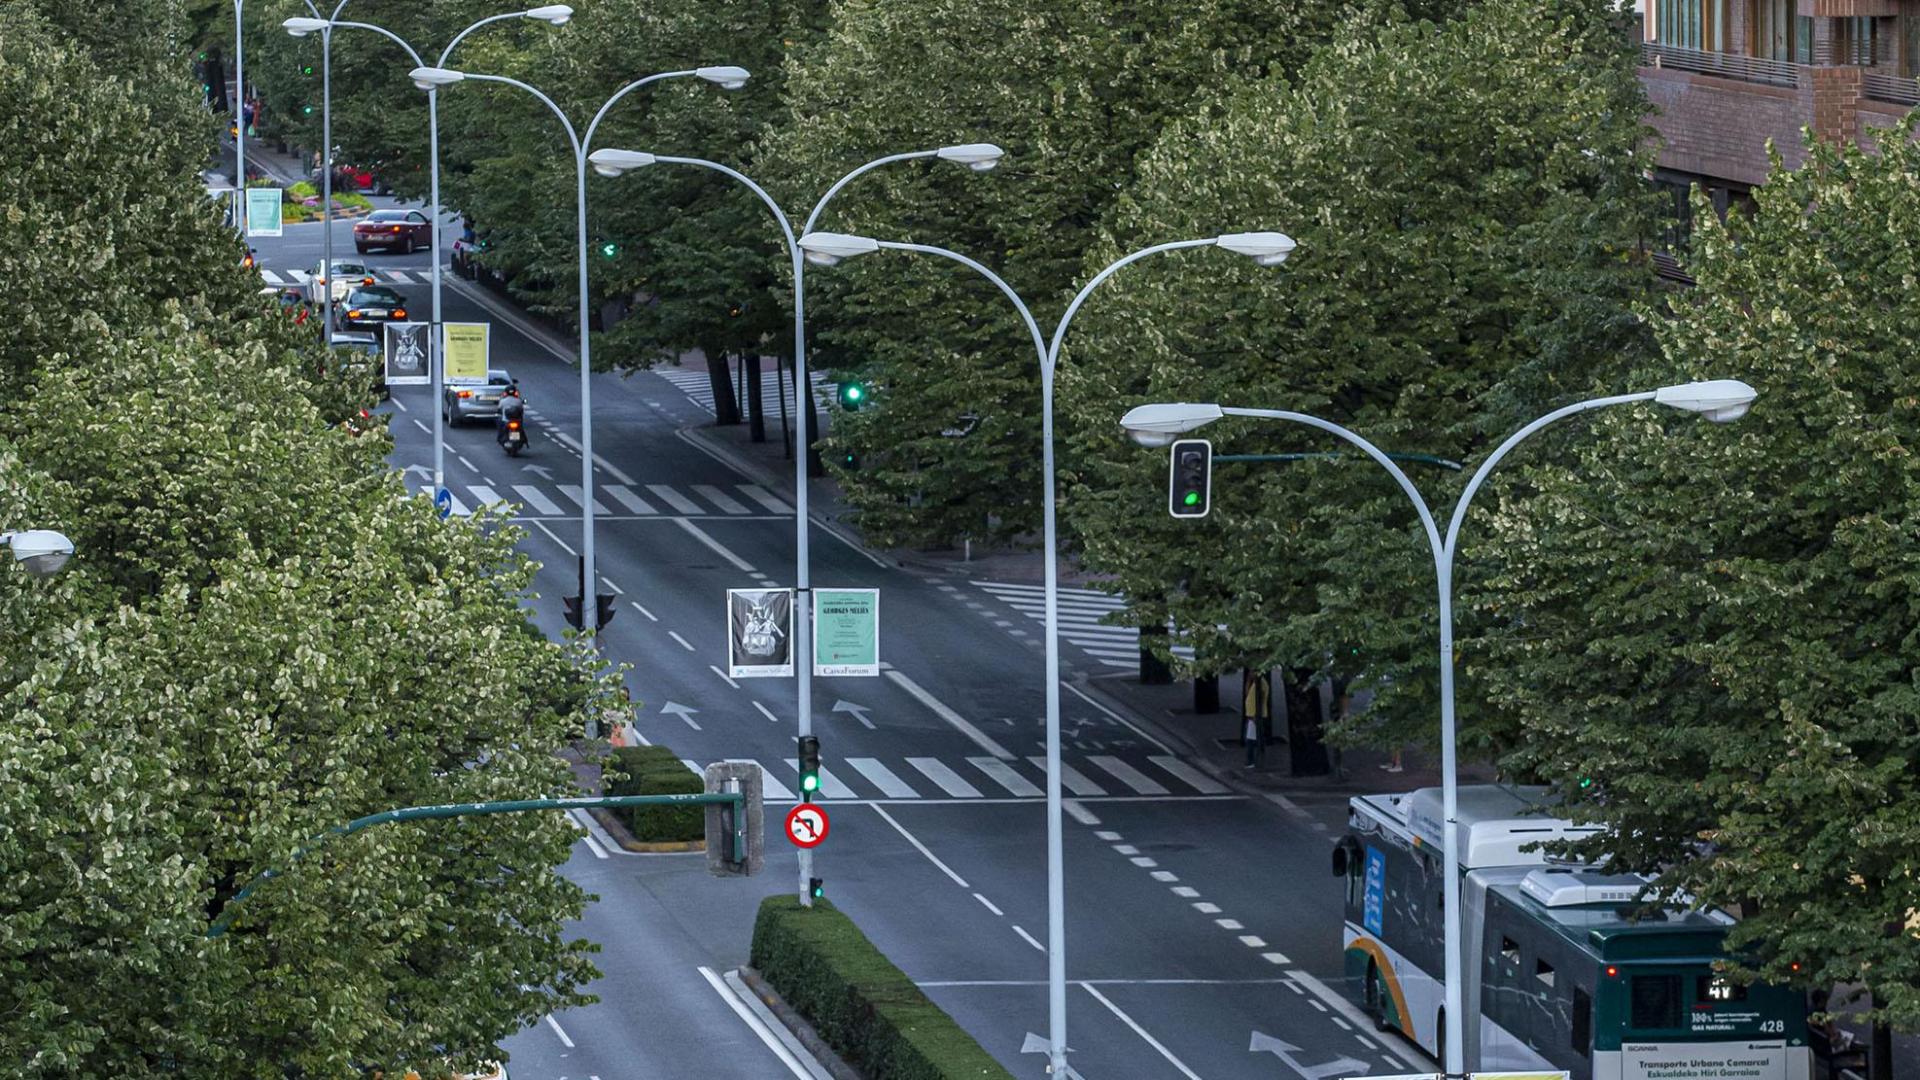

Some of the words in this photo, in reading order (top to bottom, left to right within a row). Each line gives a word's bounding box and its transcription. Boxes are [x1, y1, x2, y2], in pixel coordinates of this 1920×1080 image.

[1760, 1020, 1785, 1032] 428
[1640, 1060, 1688, 1070] Transporte
[1690, 1059, 1725, 1068] Urbano
[1727, 1058, 1770, 1067] Comarcal
[1647, 1069, 1698, 1078] Eskualdeko
[1701, 1068, 1718, 1077] Hiri
